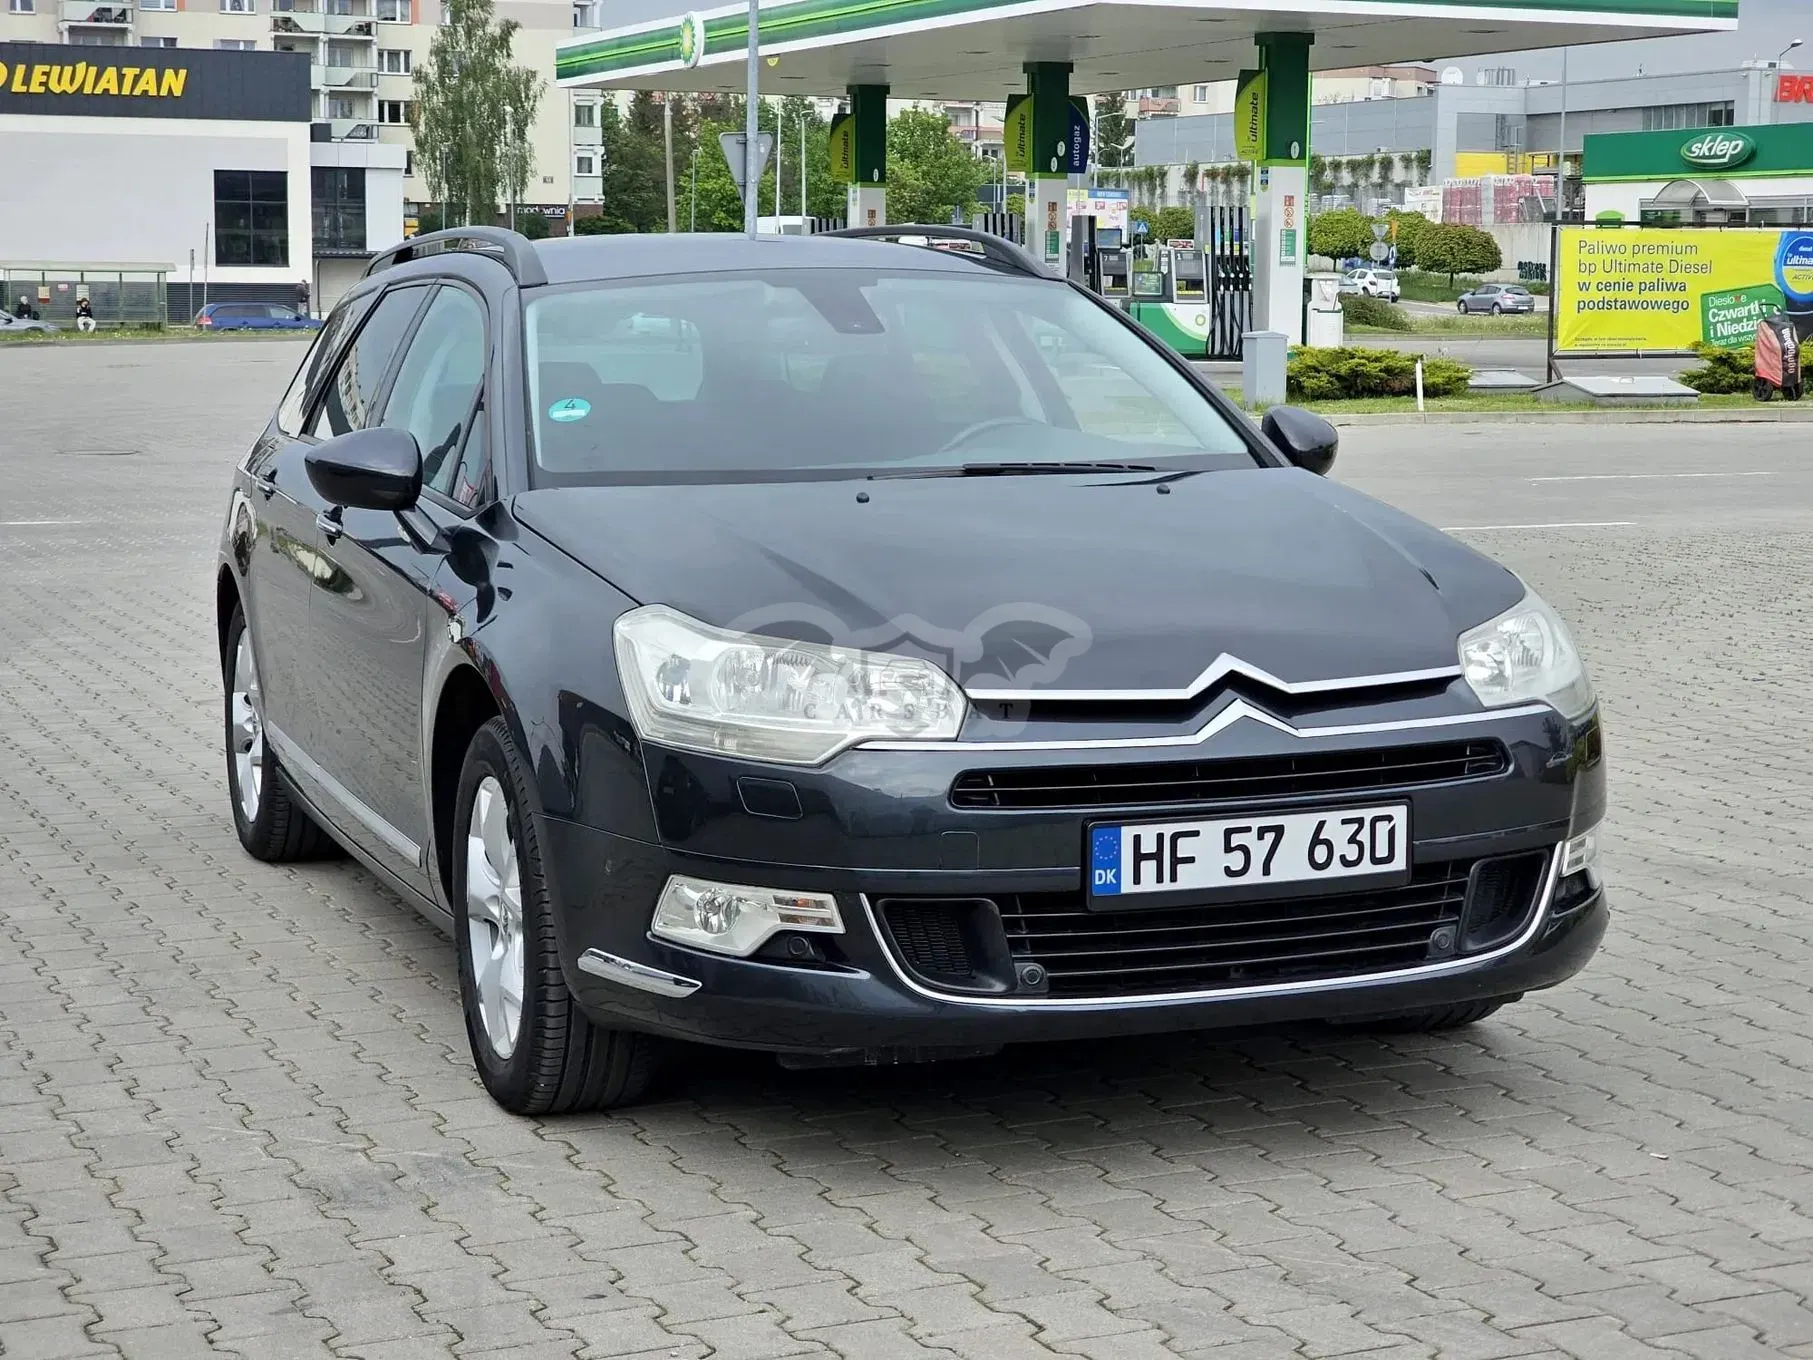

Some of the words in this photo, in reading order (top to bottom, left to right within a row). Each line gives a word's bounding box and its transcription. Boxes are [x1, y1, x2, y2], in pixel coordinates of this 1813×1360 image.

[11, 61, 187, 97] LEWIATAN
[1249, 92, 1258, 142] ultimate
[1017, 113, 1026, 157] ultimate
[1073, 125, 1081, 166] autogaz
[1689, 135, 1744, 163] sklep
[1578, 240, 1627, 255] Paliwo
[1632, 241, 1698, 258] premium
[1578, 259, 1596, 274] bp
[1602, 259, 1663, 274] Ultimate
[1669, 259, 1713, 274] Diesel
[1578, 281, 1591, 291] w
[1596, 278, 1634, 292] cenie
[1638, 279, 1687, 295] paliwa
[1577, 297, 1689, 313] podstawowego
[1709, 326, 1714, 338] i
[564, 399, 576, 410] 4
[1132, 829, 1200, 885] HF
[1223, 823, 1285, 878] 57
[1307, 814, 1396, 871] 630
[1095, 868, 1117, 885] DK
